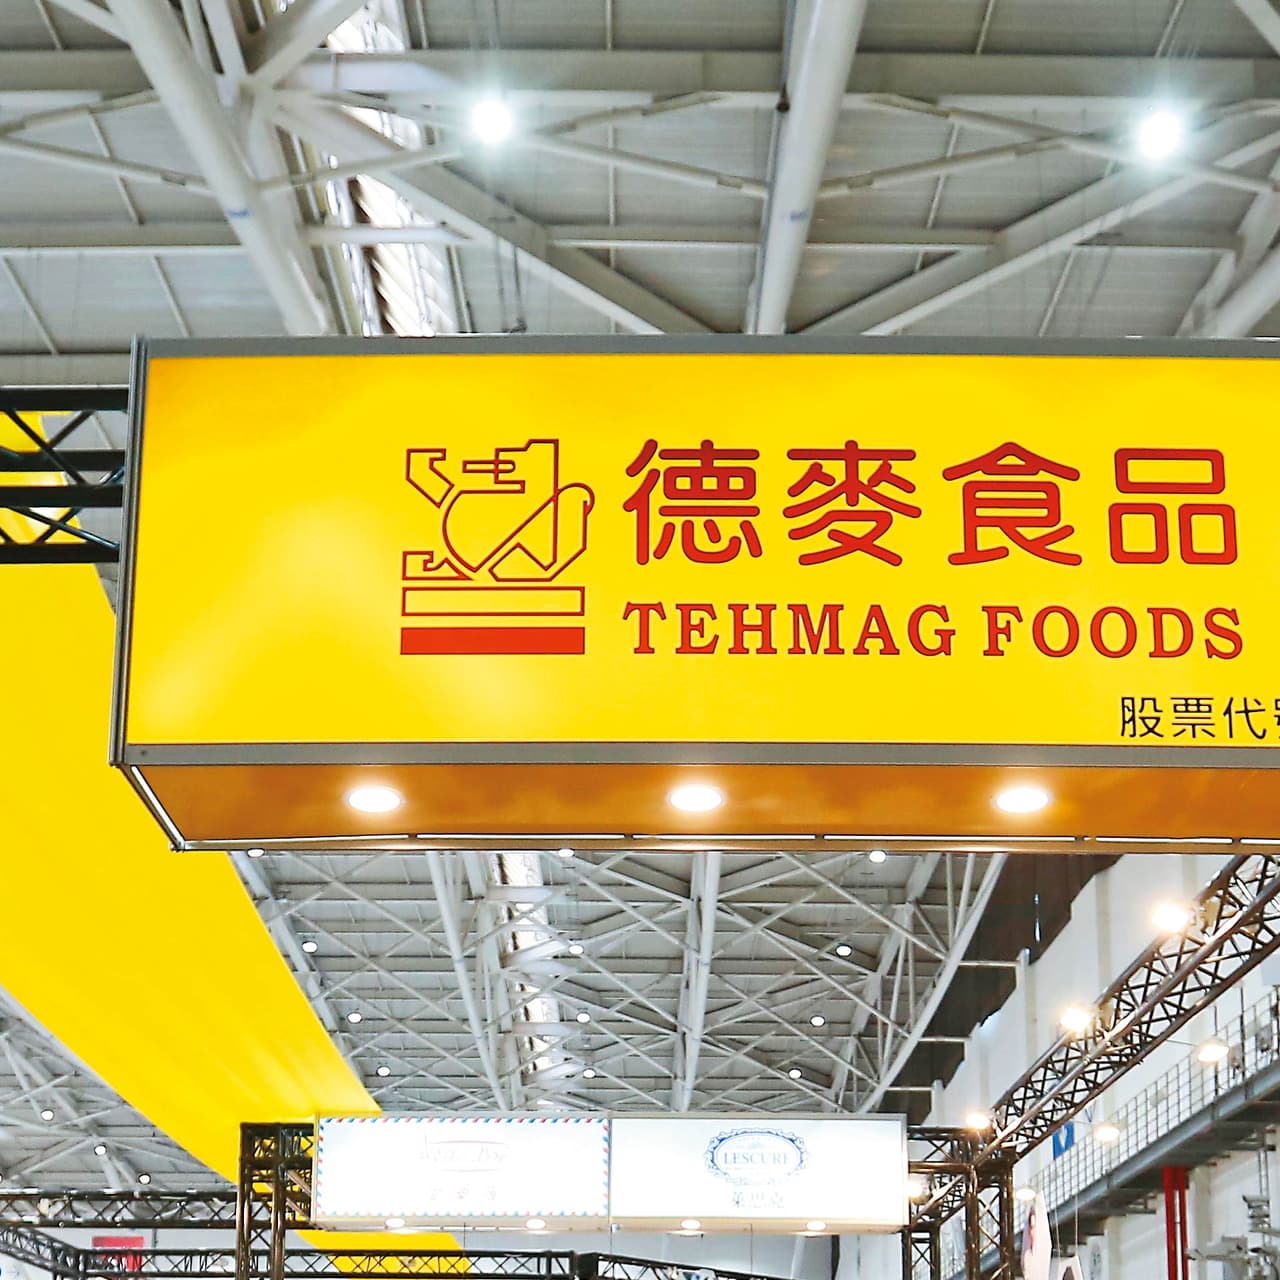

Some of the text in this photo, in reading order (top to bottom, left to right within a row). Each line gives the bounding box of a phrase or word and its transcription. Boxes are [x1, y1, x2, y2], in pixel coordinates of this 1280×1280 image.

[621, 437, 1239, 568] 德麥食品
[622, 600, 1245, 661] TEHMAG FOODS
